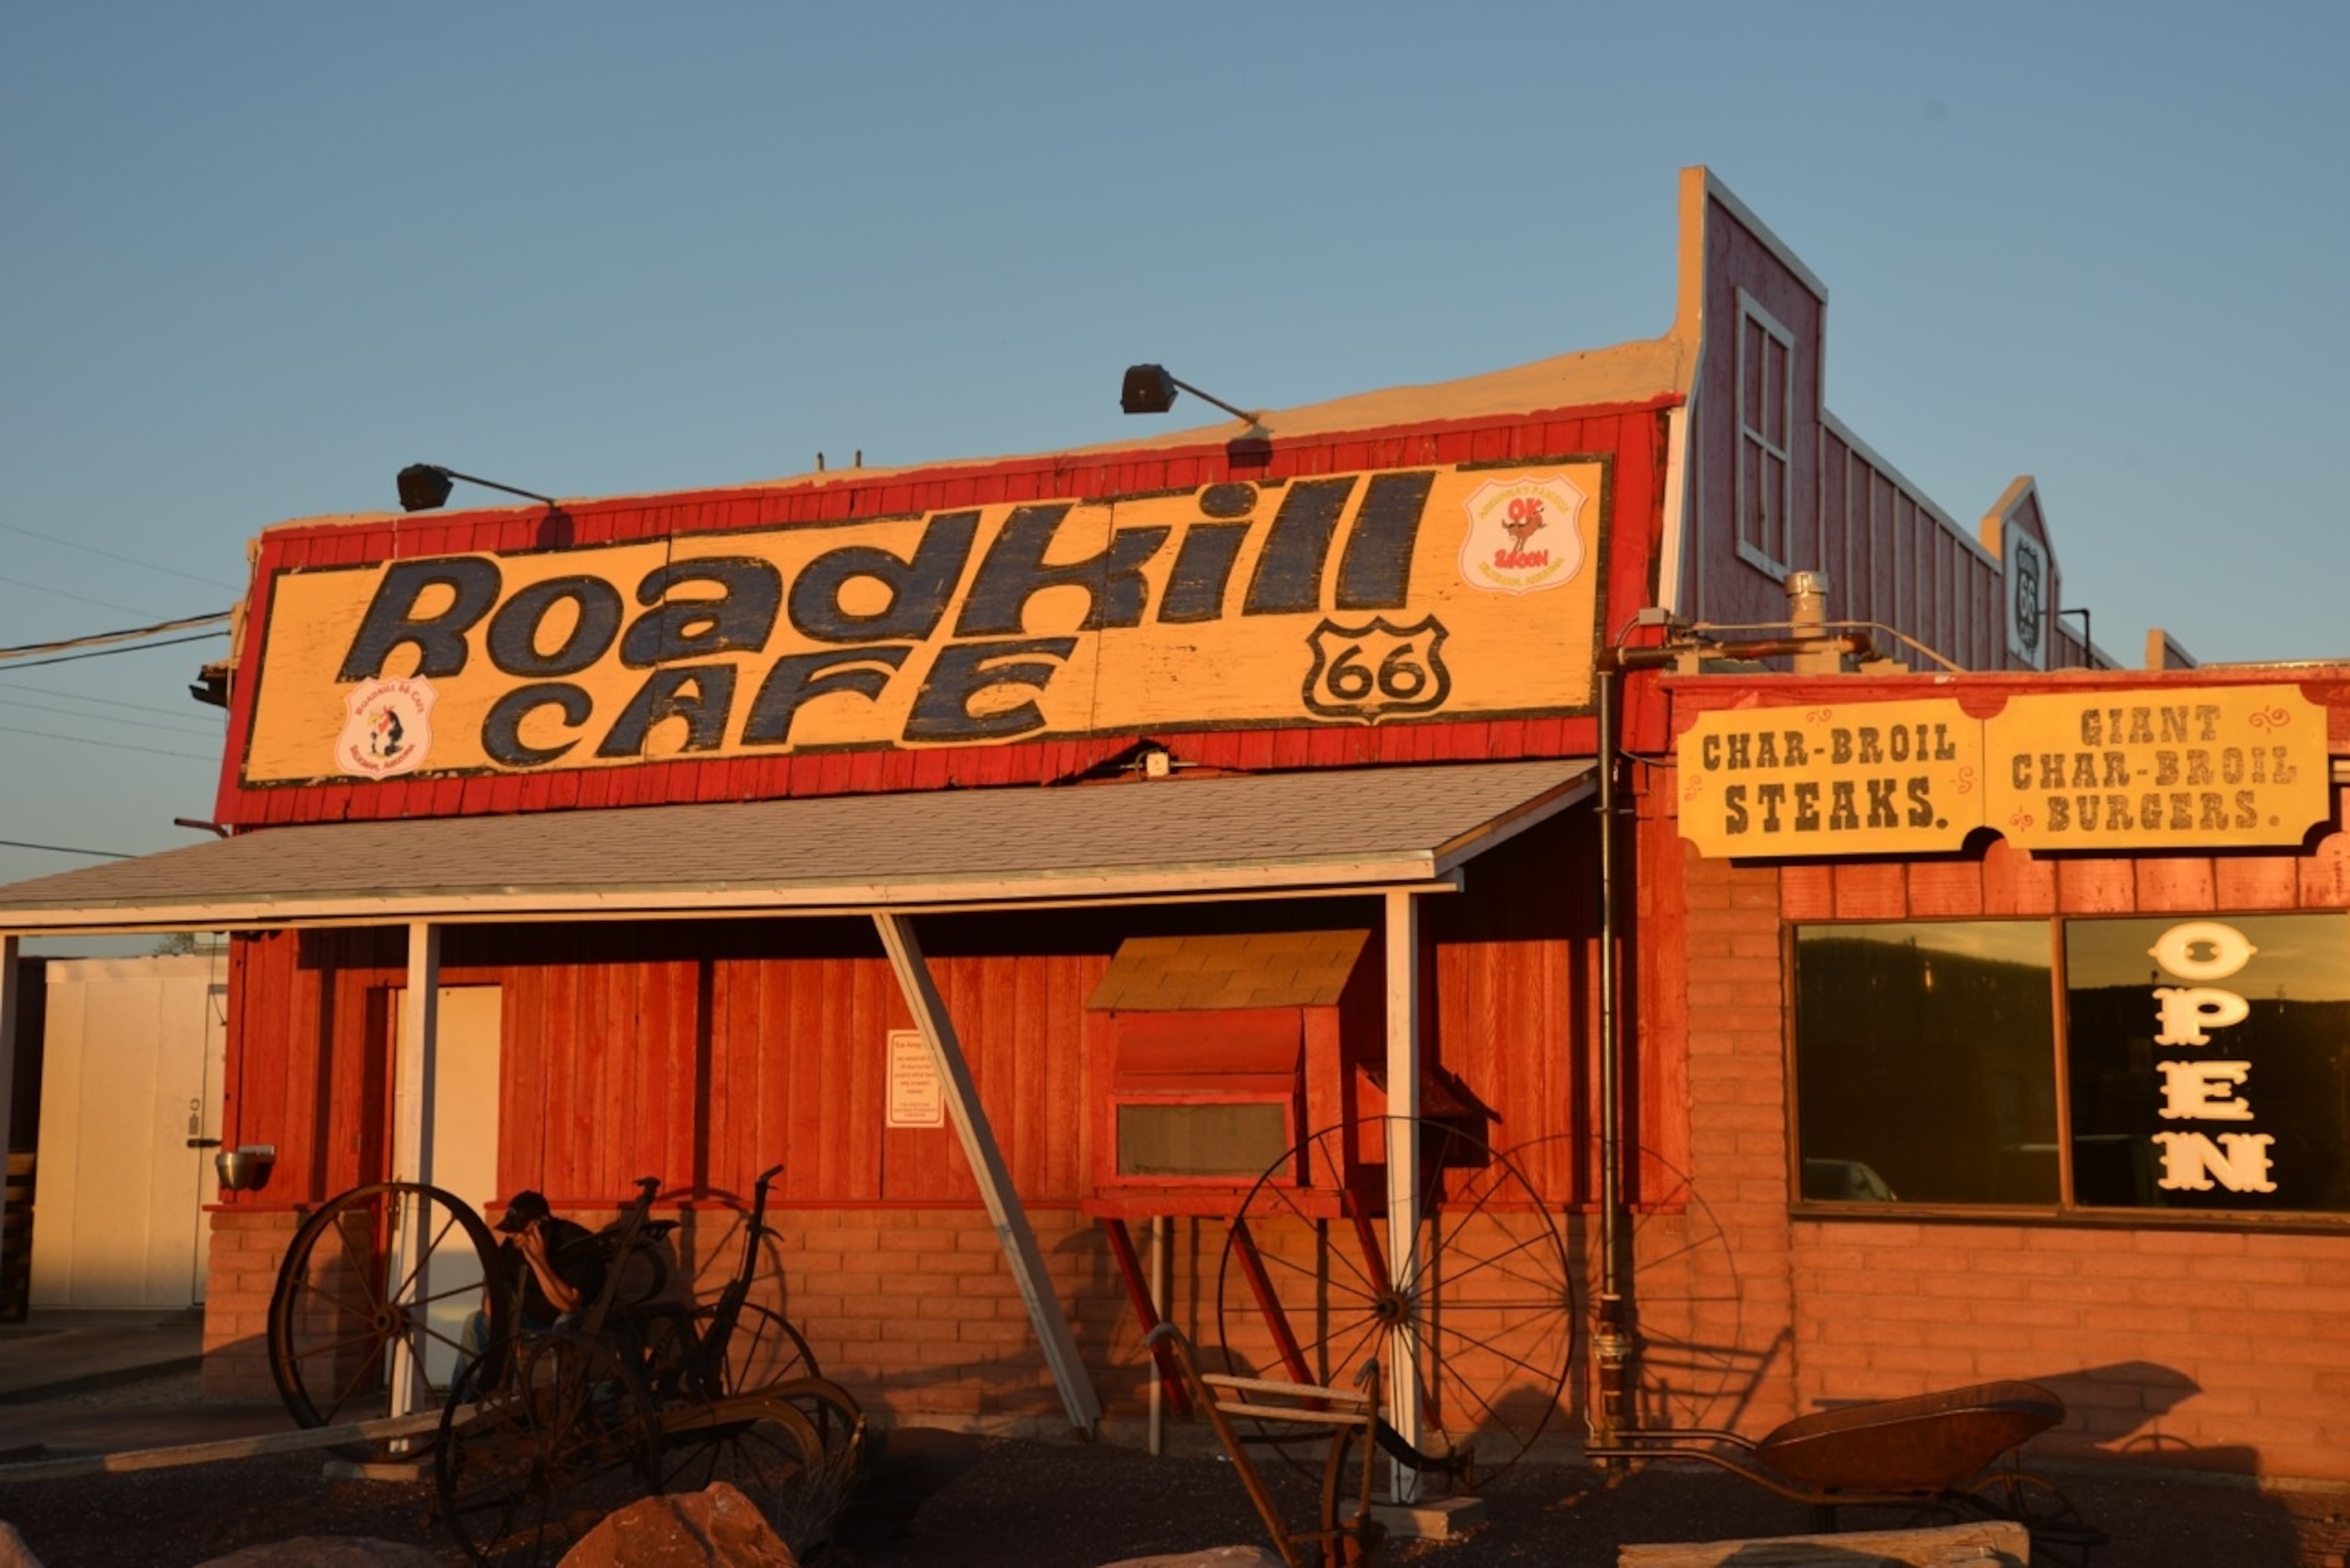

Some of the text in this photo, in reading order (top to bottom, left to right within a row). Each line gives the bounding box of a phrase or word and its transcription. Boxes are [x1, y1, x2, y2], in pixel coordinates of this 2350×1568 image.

[1508, 498, 1542, 521] OK
[2019, 572, 2035, 624] 66
[1326, 642, 1425, 700] 66
[481, 636, 1079, 765] CAFE
[2080, 704, 2222, 747] GIANT
[1701, 724, 1956, 772] CHAR-BROIL
[2011, 746, 2296, 792] CHAR-BROIL
[1724, 776, 1949, 834] STEAKS.
[2046, 789, 2281, 833] BURGERS.
[2147, 921, 2278, 1193] OPEN
